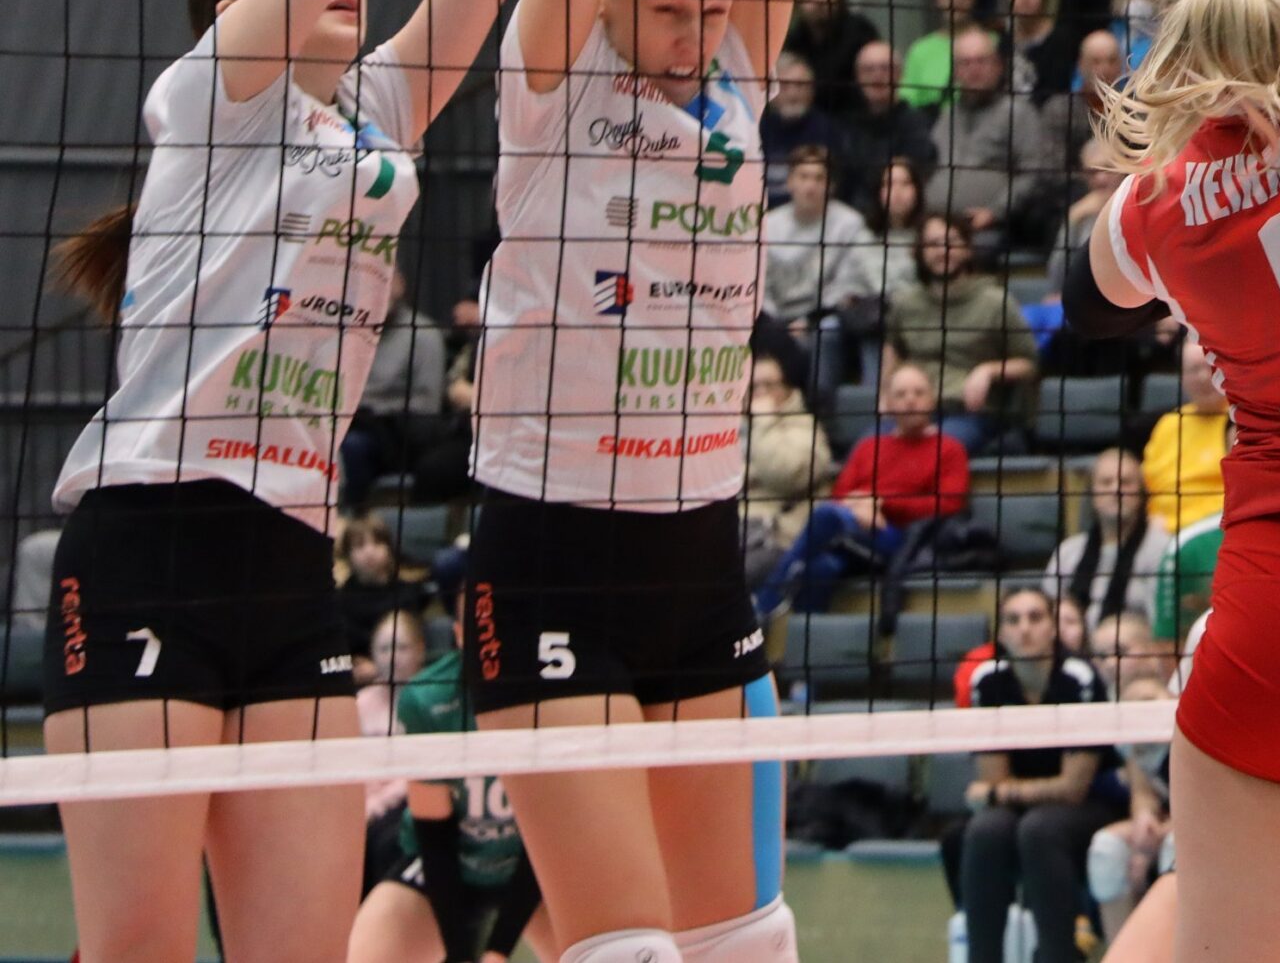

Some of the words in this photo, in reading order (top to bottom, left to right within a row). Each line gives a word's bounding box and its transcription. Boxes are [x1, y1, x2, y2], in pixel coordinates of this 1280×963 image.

[694, 132, 744, 184] 5
[126, 627, 163, 677] 7
[475, 582, 502, 681] renta
[538, 631, 577, 680] 5
